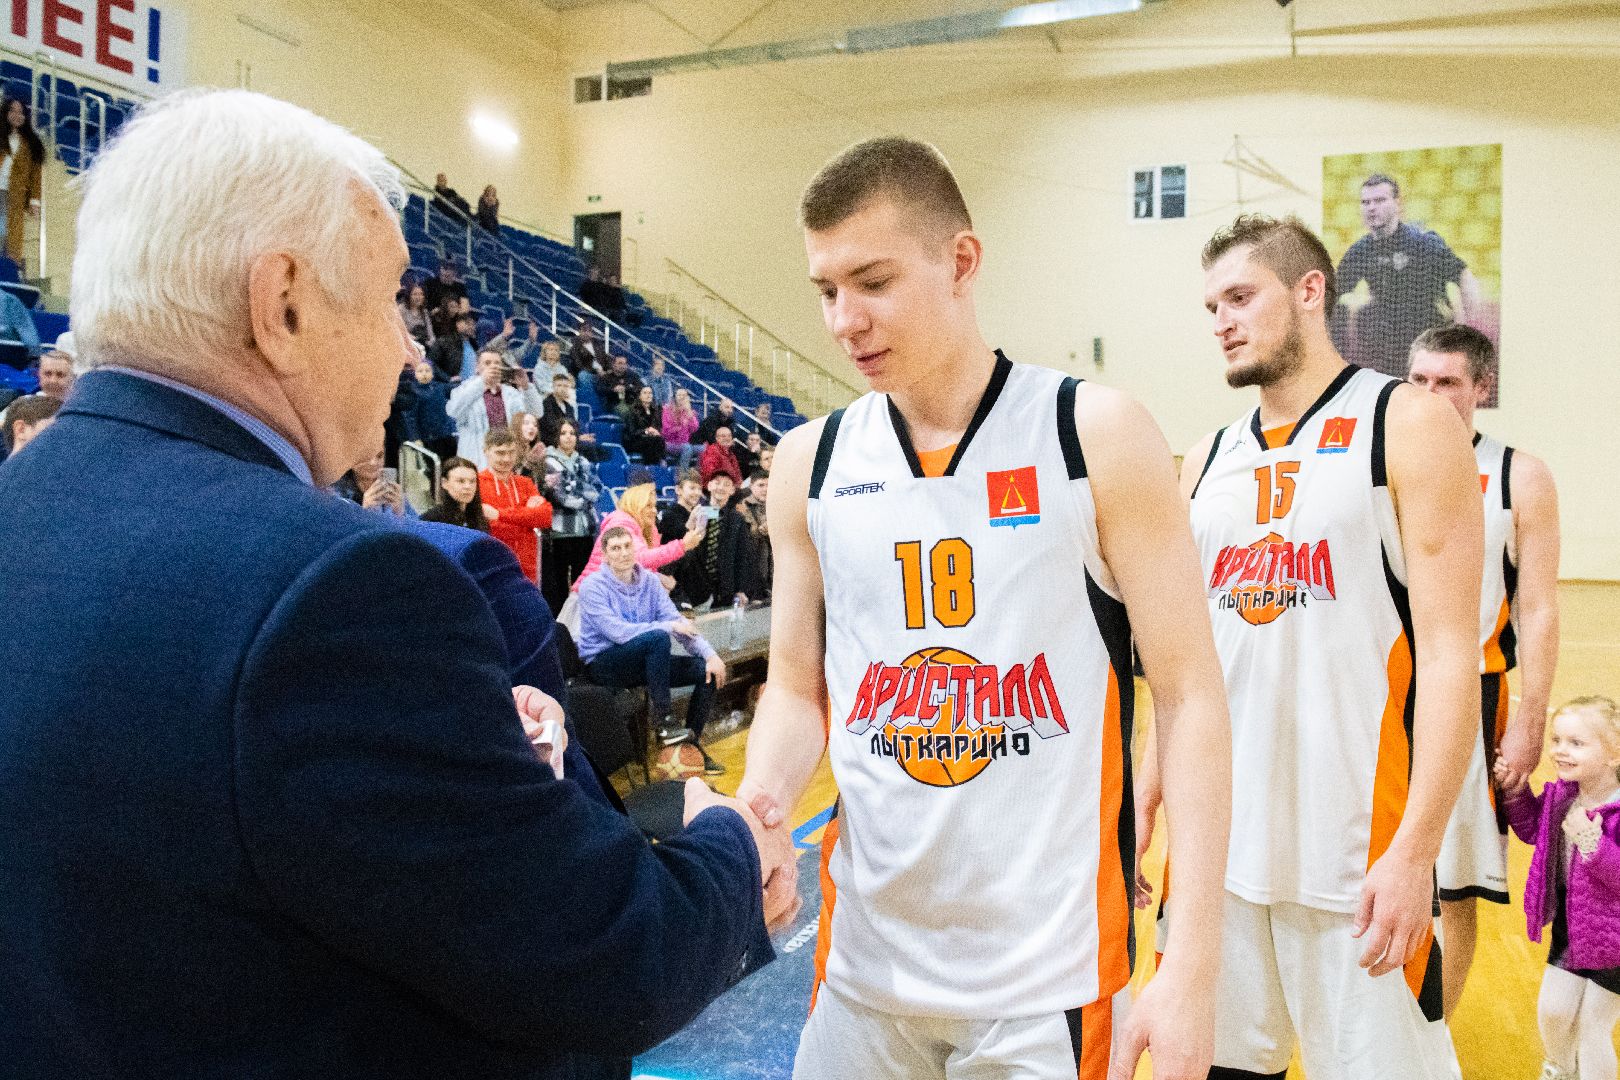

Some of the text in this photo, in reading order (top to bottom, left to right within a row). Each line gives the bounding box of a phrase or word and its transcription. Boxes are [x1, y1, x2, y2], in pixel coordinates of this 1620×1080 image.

[1254, 461, 1301, 524] 15
[894, 537, 976, 630] 18
[1218, 589, 1308, 611] ЛЫТКРИН
[846, 653, 1071, 739] КРИСТАЛЛ
[870, 731, 1031, 761] ЛЫТКАРИНО
